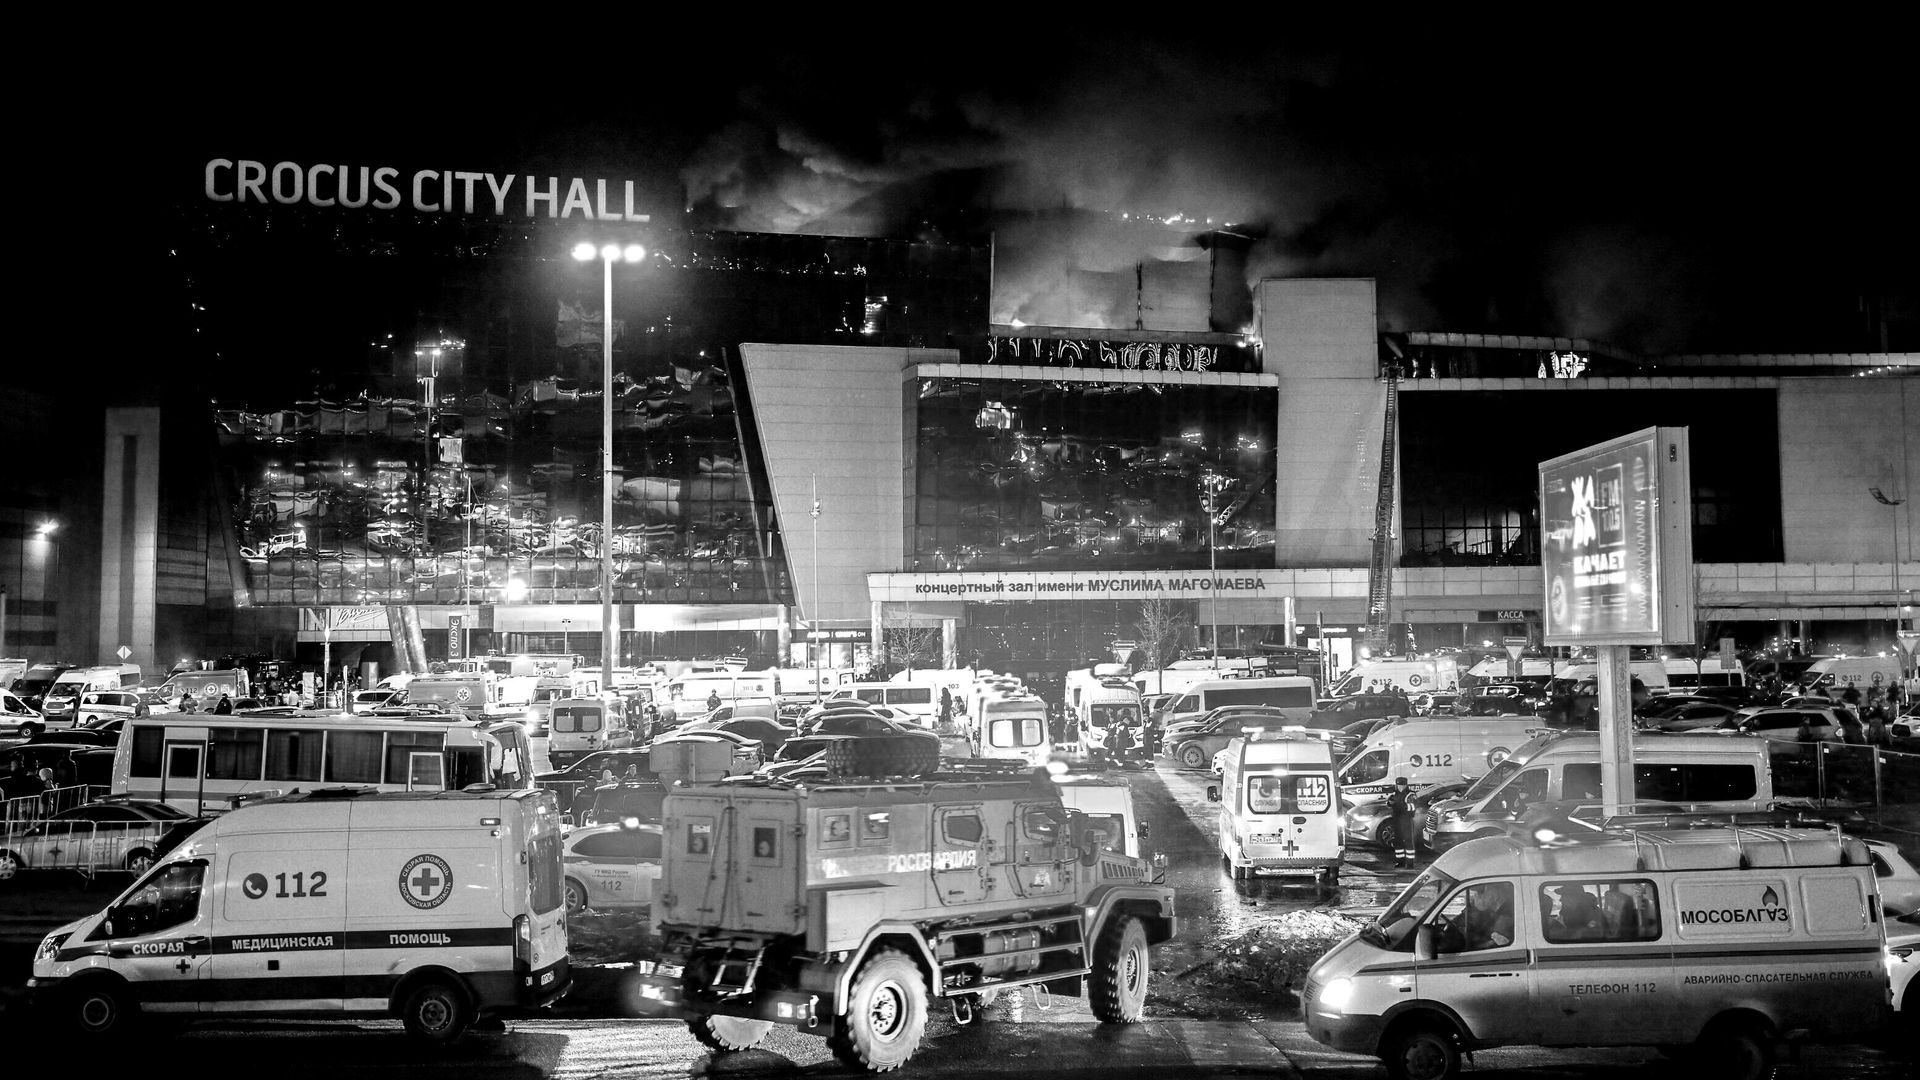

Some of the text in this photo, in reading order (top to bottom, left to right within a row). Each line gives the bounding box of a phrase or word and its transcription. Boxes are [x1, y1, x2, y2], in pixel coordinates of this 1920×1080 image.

[205, 158, 650, 222] CROCUS CITY HALL
[915, 578, 1266, 595] концертный зал имени МУСЛИМА МАГОМАЕВА
[1497, 610, 1524, 619] КАССА
[1379, 678, 1392, 686] 112
[1849, 674, 1862, 682] 112
[1425, 754, 1453, 768] 112
[1298, 783, 1326, 798] 112
[1356, 785, 1383, 794] СКОРАЯ
[401, 855, 450, 877] СКОРАЯ ПОМОЩЬ
[887, 850, 977, 873] РОСГВАРДИЯ
[275, 871, 327, 898] 112
[601, 880, 622, 891] 112
[132, 933, 451, 954] СКОРАЯ МЕДИЦИНСКАЯ ПОМОЩЬ
[1684, 970, 1873, 985] АВАРИЙНО-СПАСАТЕЛЬНАЯ СЛУЖБА
[1568, 982, 1656, 995] ТЕЛЕФОН 112
